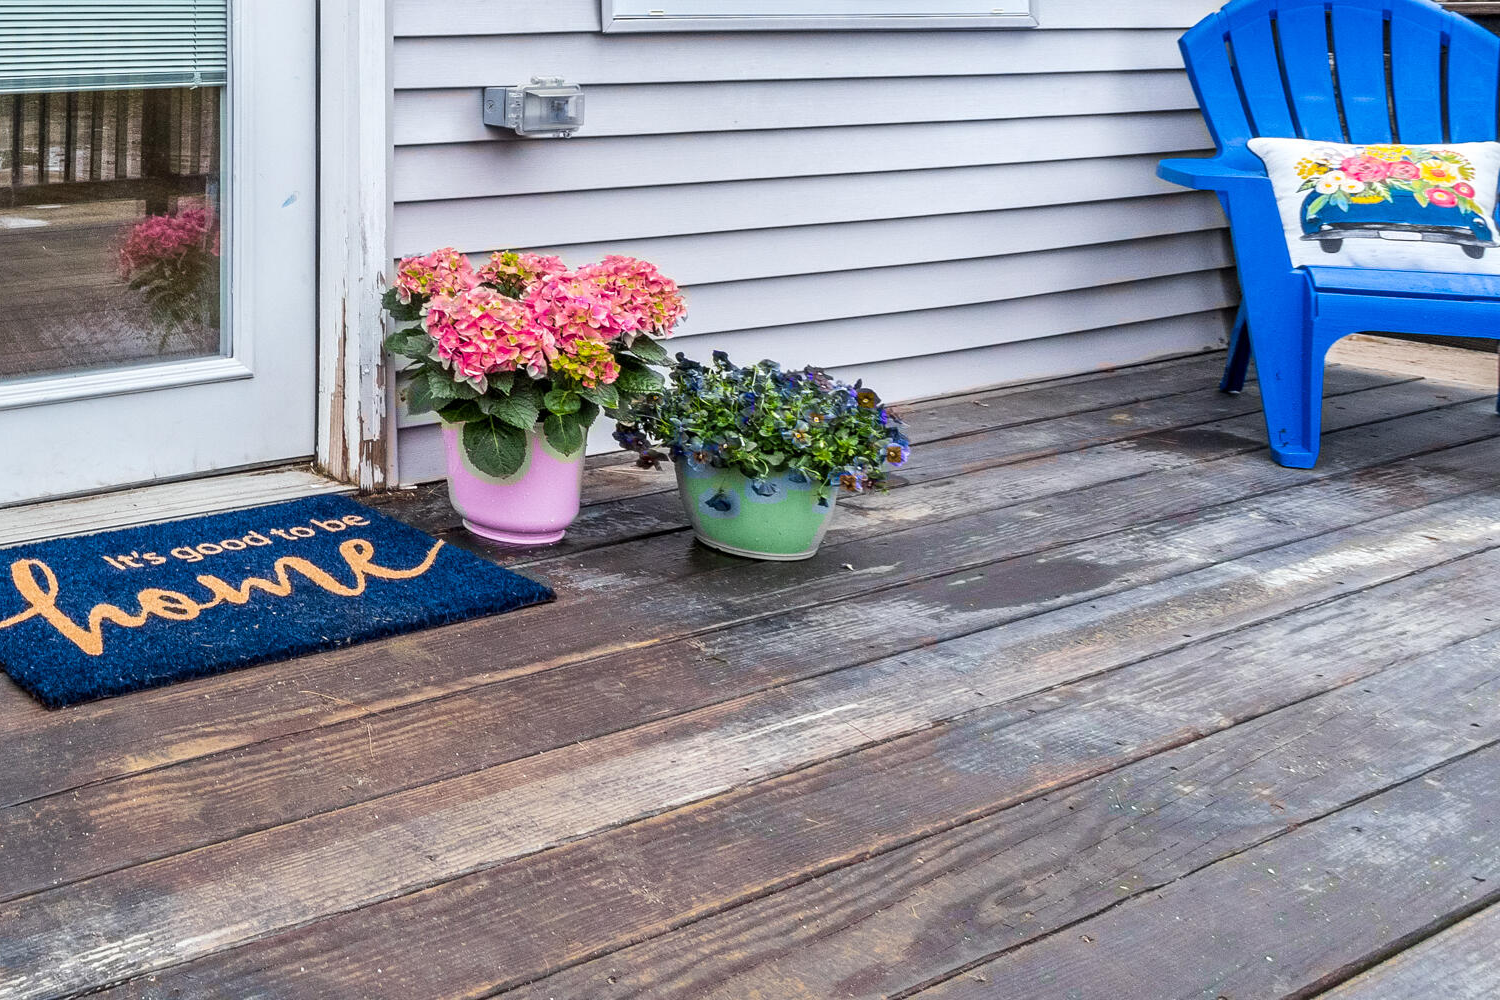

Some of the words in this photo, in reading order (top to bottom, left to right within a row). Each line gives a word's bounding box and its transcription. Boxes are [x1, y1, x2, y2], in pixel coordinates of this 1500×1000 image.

[101, 550, 167, 571] It's
[170, 530, 273, 563] good
[270, 525, 316, 541] to
[310, 514, 371, 533] be
